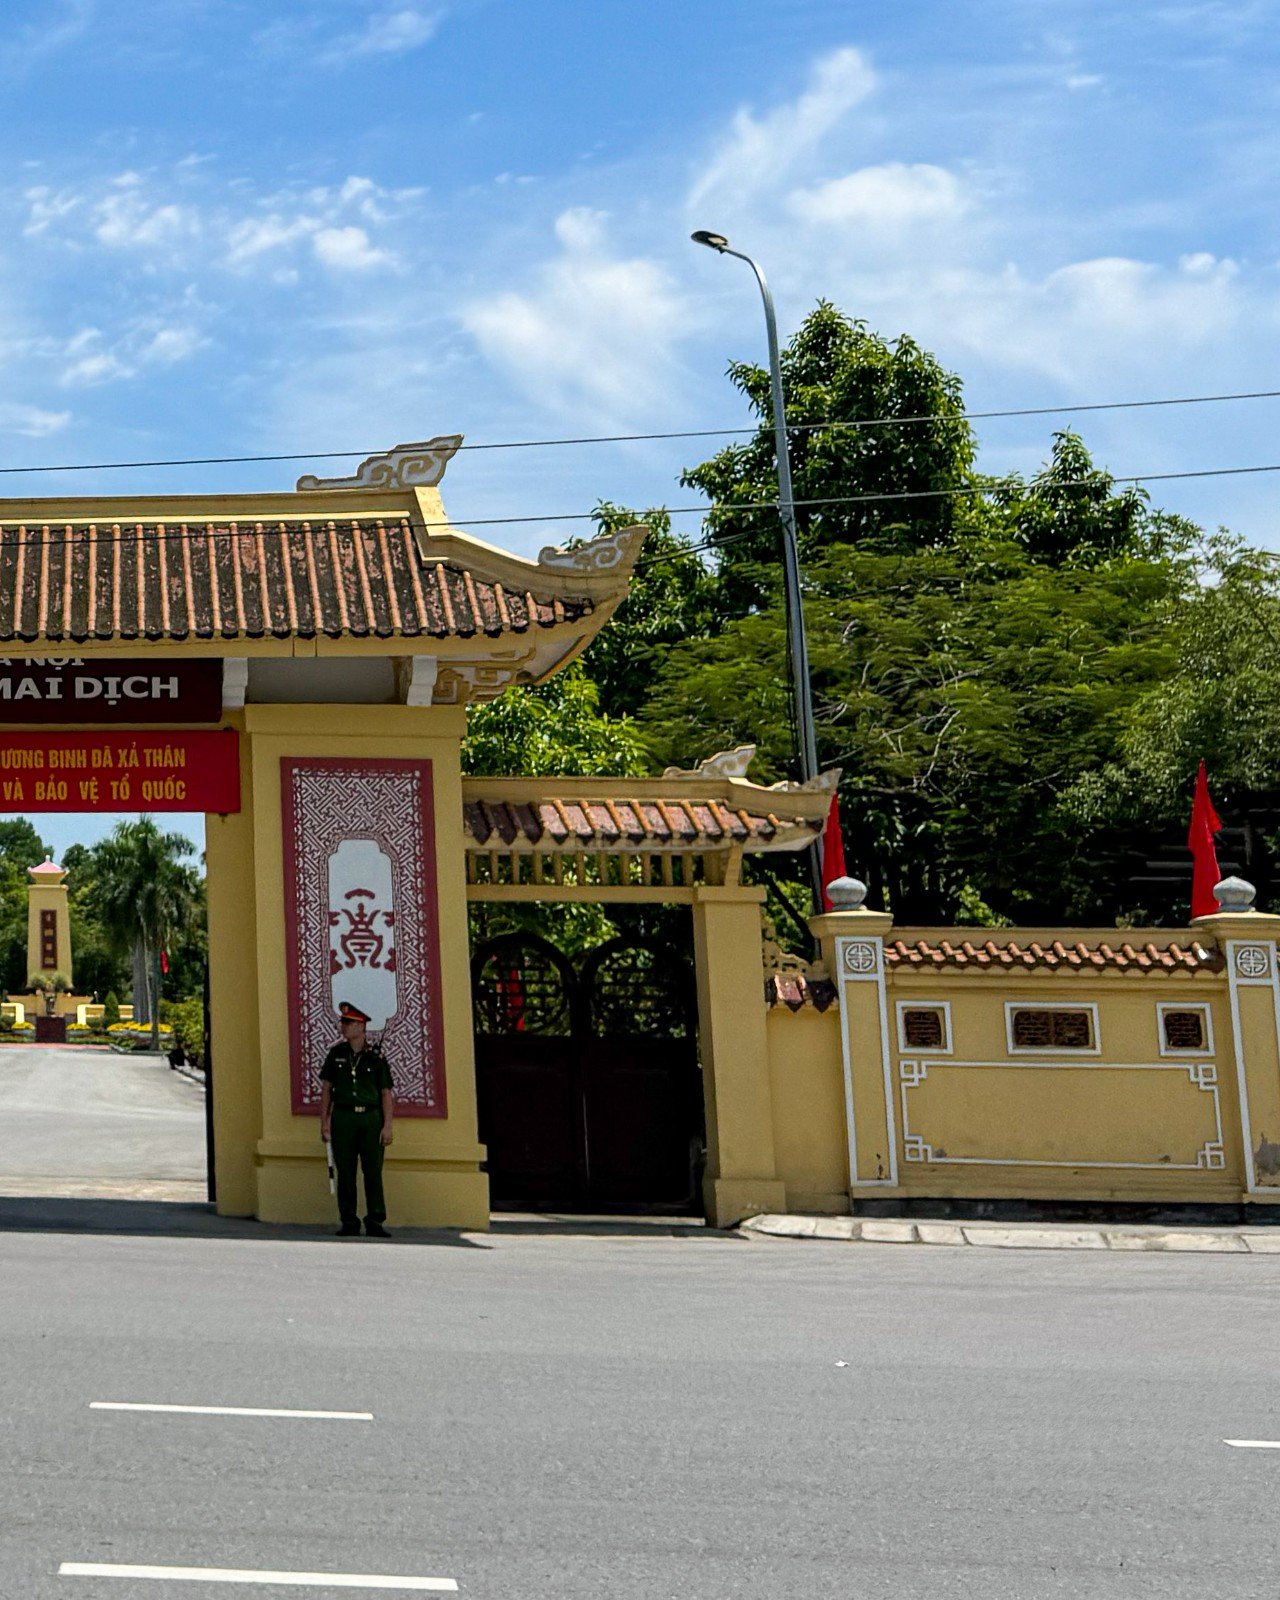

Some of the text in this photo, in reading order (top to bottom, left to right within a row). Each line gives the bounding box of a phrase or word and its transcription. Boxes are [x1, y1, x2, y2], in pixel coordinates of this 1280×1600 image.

[75, 675, 179, 706] DỊCH
[48, 749, 87, 769] BINH
[91, 745, 114, 768] ĐÃ
[117, 741, 139, 768] XẢ
[143, 744, 186, 768] THÂN
[2, 776, 24, 801] VÀ
[35, 773, 68, 801] BẢO
[79, 776, 100, 804] VỆ
[110, 772, 131, 801] TỔ
[141, 774, 187, 802] QUỐC
